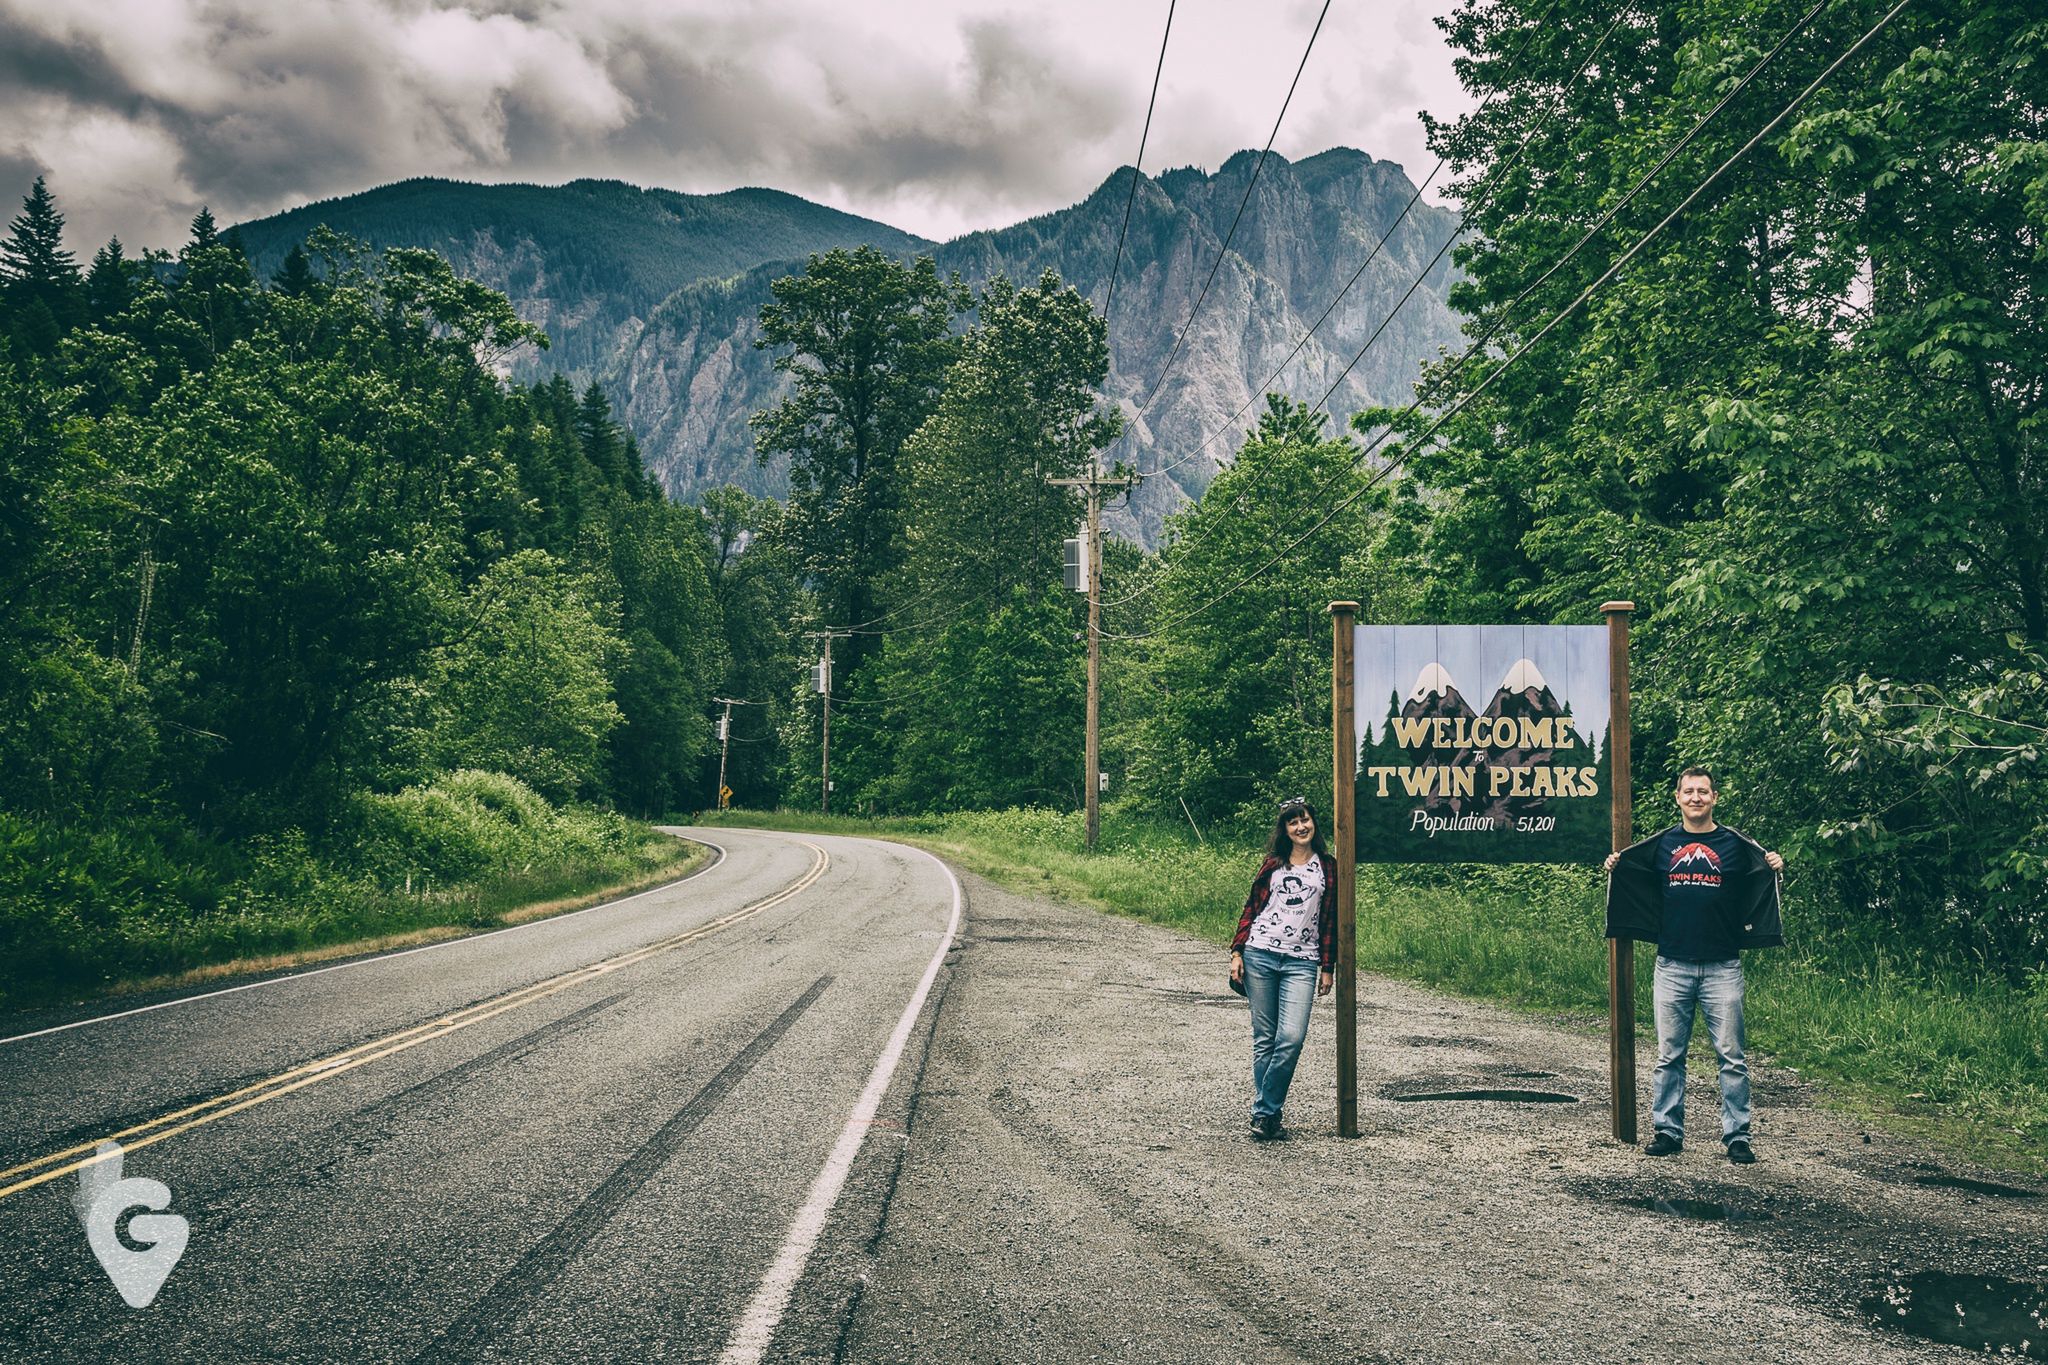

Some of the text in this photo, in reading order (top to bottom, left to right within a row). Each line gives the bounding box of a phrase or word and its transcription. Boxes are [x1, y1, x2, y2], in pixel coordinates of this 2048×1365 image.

[1391, 716, 1575, 749] WELCOME
[1473, 750, 1485, 762] To
[1368, 766, 1599, 798] TWIN PEAKS
[1410, 810, 1556, 838] Population 51,201
[1693, 874, 1721, 883] PEAKS
